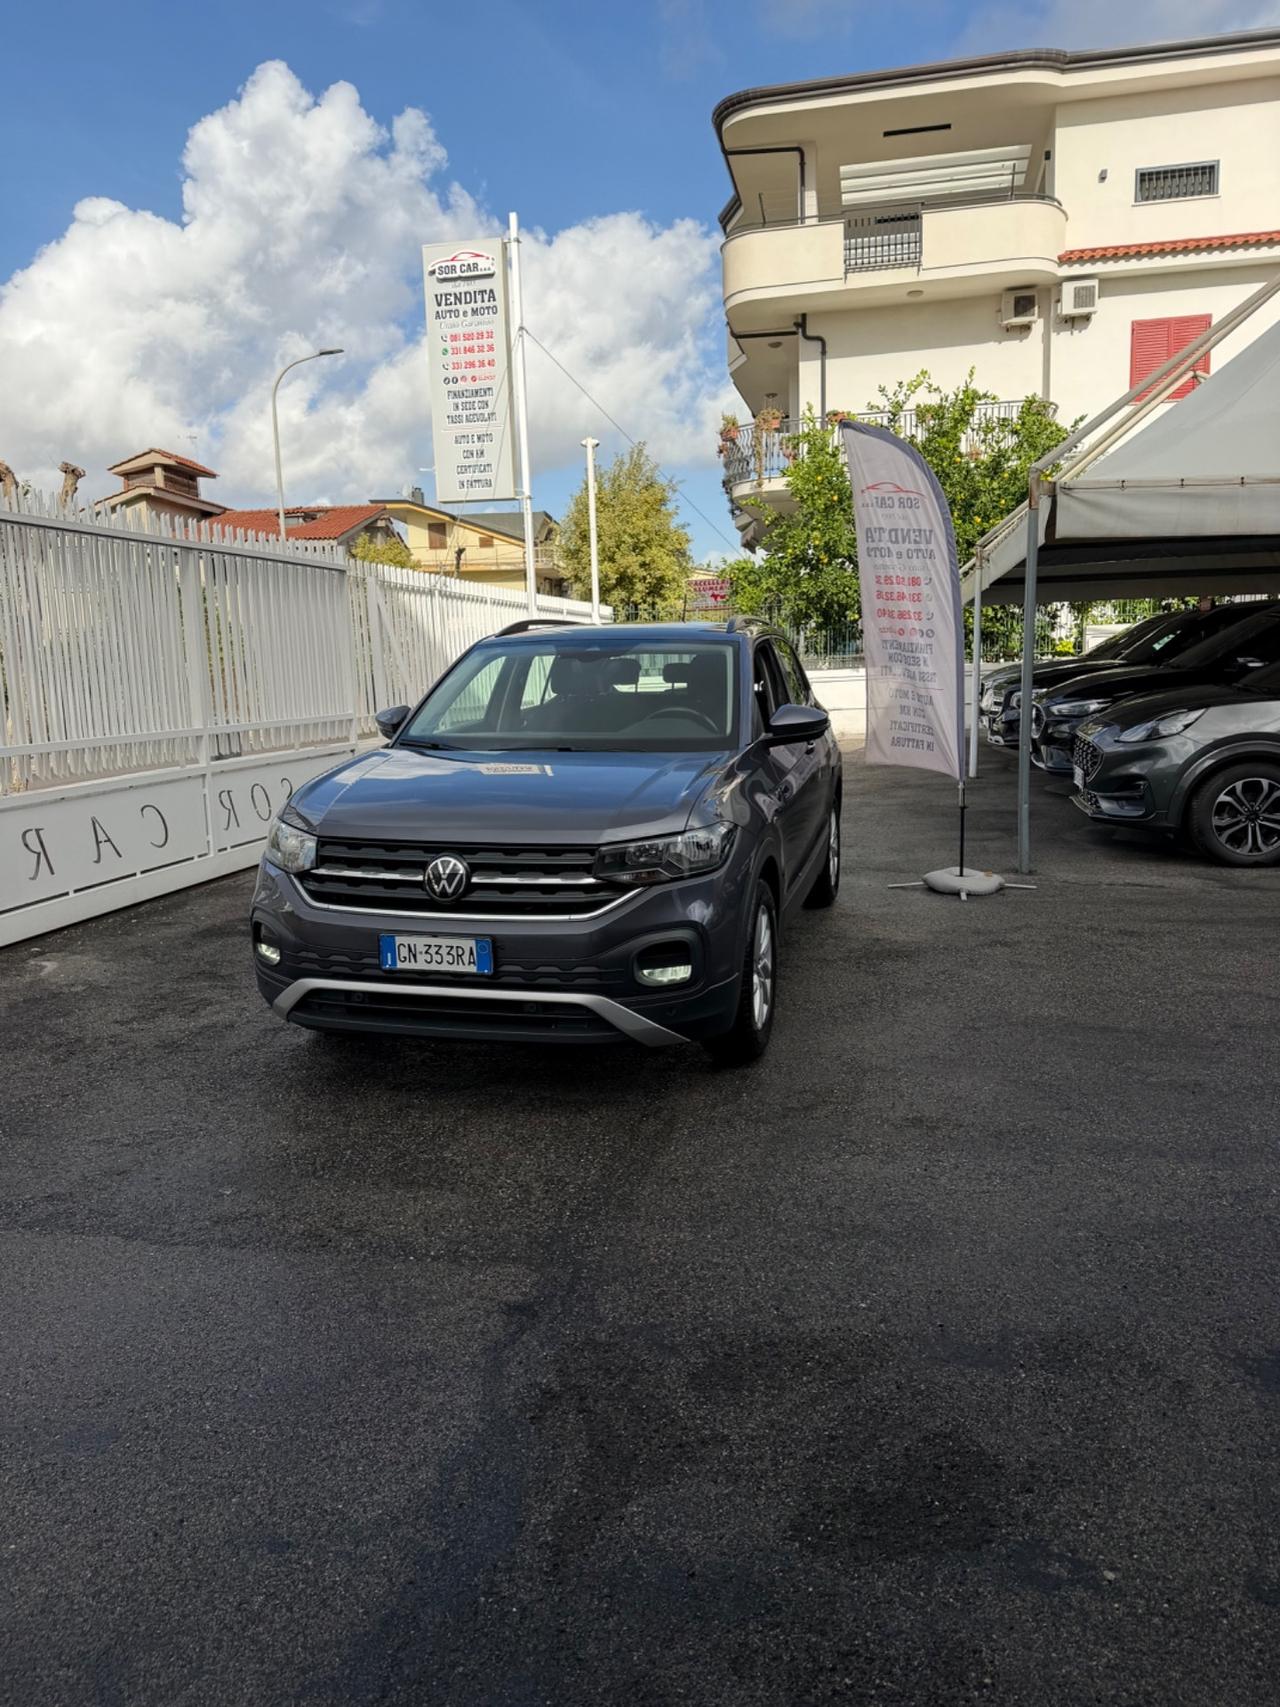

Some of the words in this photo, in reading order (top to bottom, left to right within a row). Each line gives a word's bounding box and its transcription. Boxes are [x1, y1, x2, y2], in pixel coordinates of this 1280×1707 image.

[437, 264, 457, 276] SOR
[434, 289, 496, 307] VENDITA
[435, 309, 460, 320] AUTO
[471, 305, 498, 316] MOTO
[447, 387, 493, 400] FINANZIAMENTI
[477, 400, 489, 410] CON
[447, 414, 463, 425] TASSI
[465, 412, 497, 424] AGEVOLATI
[454, 435, 470, 445] AUTO
[477, 433, 493, 443] MOTO
[463, 449, 474, 460] CON
[456, 464, 493, 475] CERTIFICATI
[458, 480, 465, 489] IN
[466, 479, 492, 489] FATTURA
